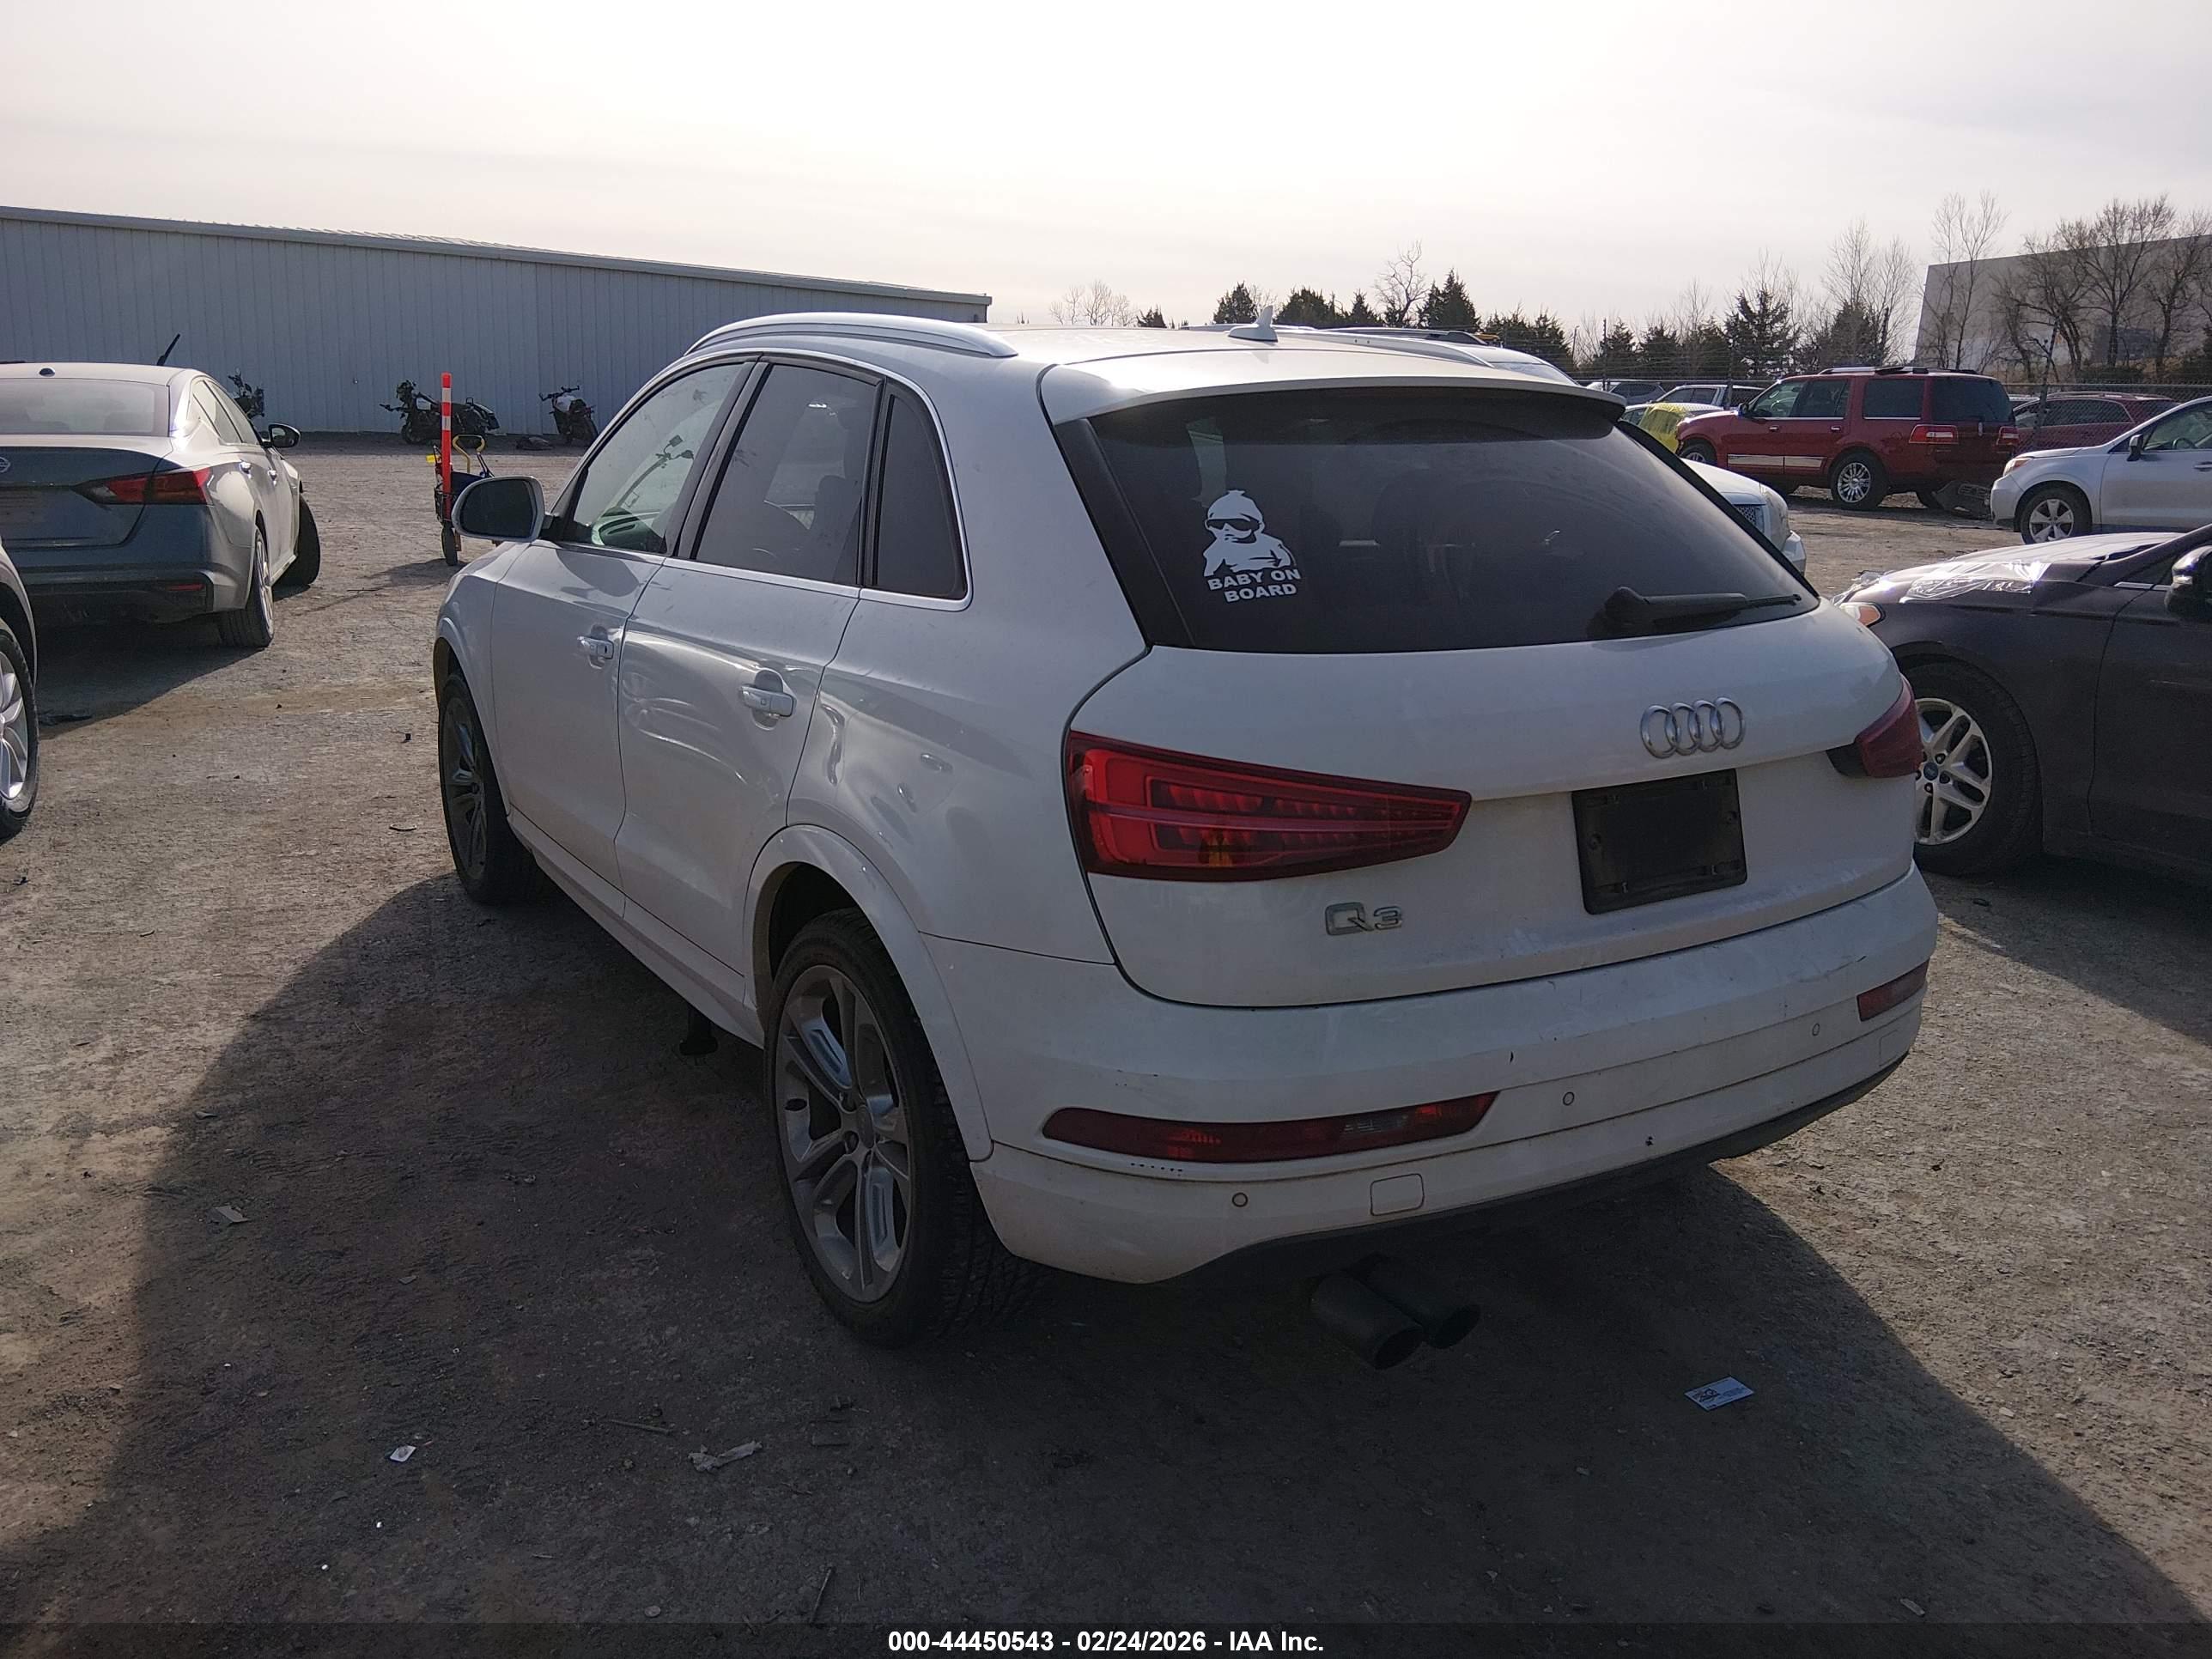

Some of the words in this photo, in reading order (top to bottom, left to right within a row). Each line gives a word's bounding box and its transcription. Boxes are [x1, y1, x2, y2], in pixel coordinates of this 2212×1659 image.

[1207, 572, 1264, 590] BABY
[1271, 568, 1302, 581] ON
[1224, 584, 1297, 603] BOARD
[1325, 901, 1402, 936] Q3
